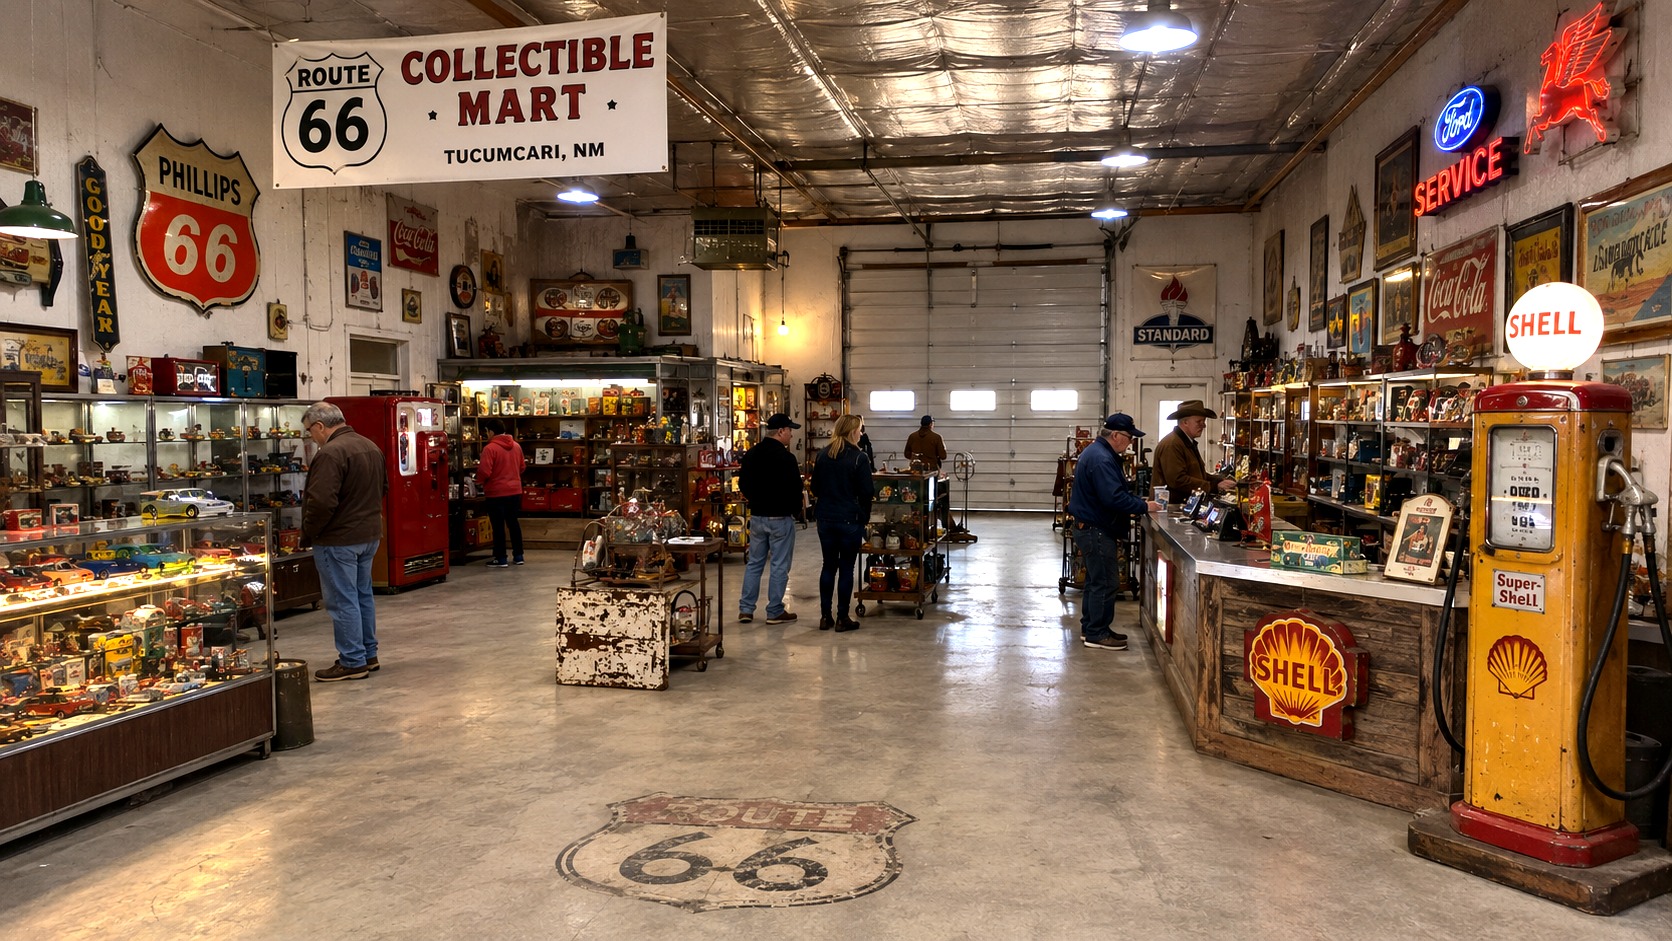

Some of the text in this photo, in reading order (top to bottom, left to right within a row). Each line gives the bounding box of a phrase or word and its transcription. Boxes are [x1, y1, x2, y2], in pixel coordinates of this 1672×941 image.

[298, 64, 370, 87] ROUTE
[401, 32, 655, 86] COLLECTIBLE
[298, 96, 369, 154] 66
[458, 83, 587, 127] MART
[1442, 97, 1475, 142] Ford
[444, 142, 605, 164] TUCUMCARI, NM
[159, 156, 242, 206] PHILLIPS
[1414, 137, 1503, 217] SERVICE
[163, 214, 238, 283] 66
[1137, 327, 1210, 342] STANDARD
[1509, 311, 1582, 339] SHELL
[1497, 573, 1542, 592] Super-
[1499, 590, 1539, 607] Shell
[1256, 655, 1338, 697] SHELL
[660, 803, 857, 829] ROUTE
[618, 831, 829, 892] 66
